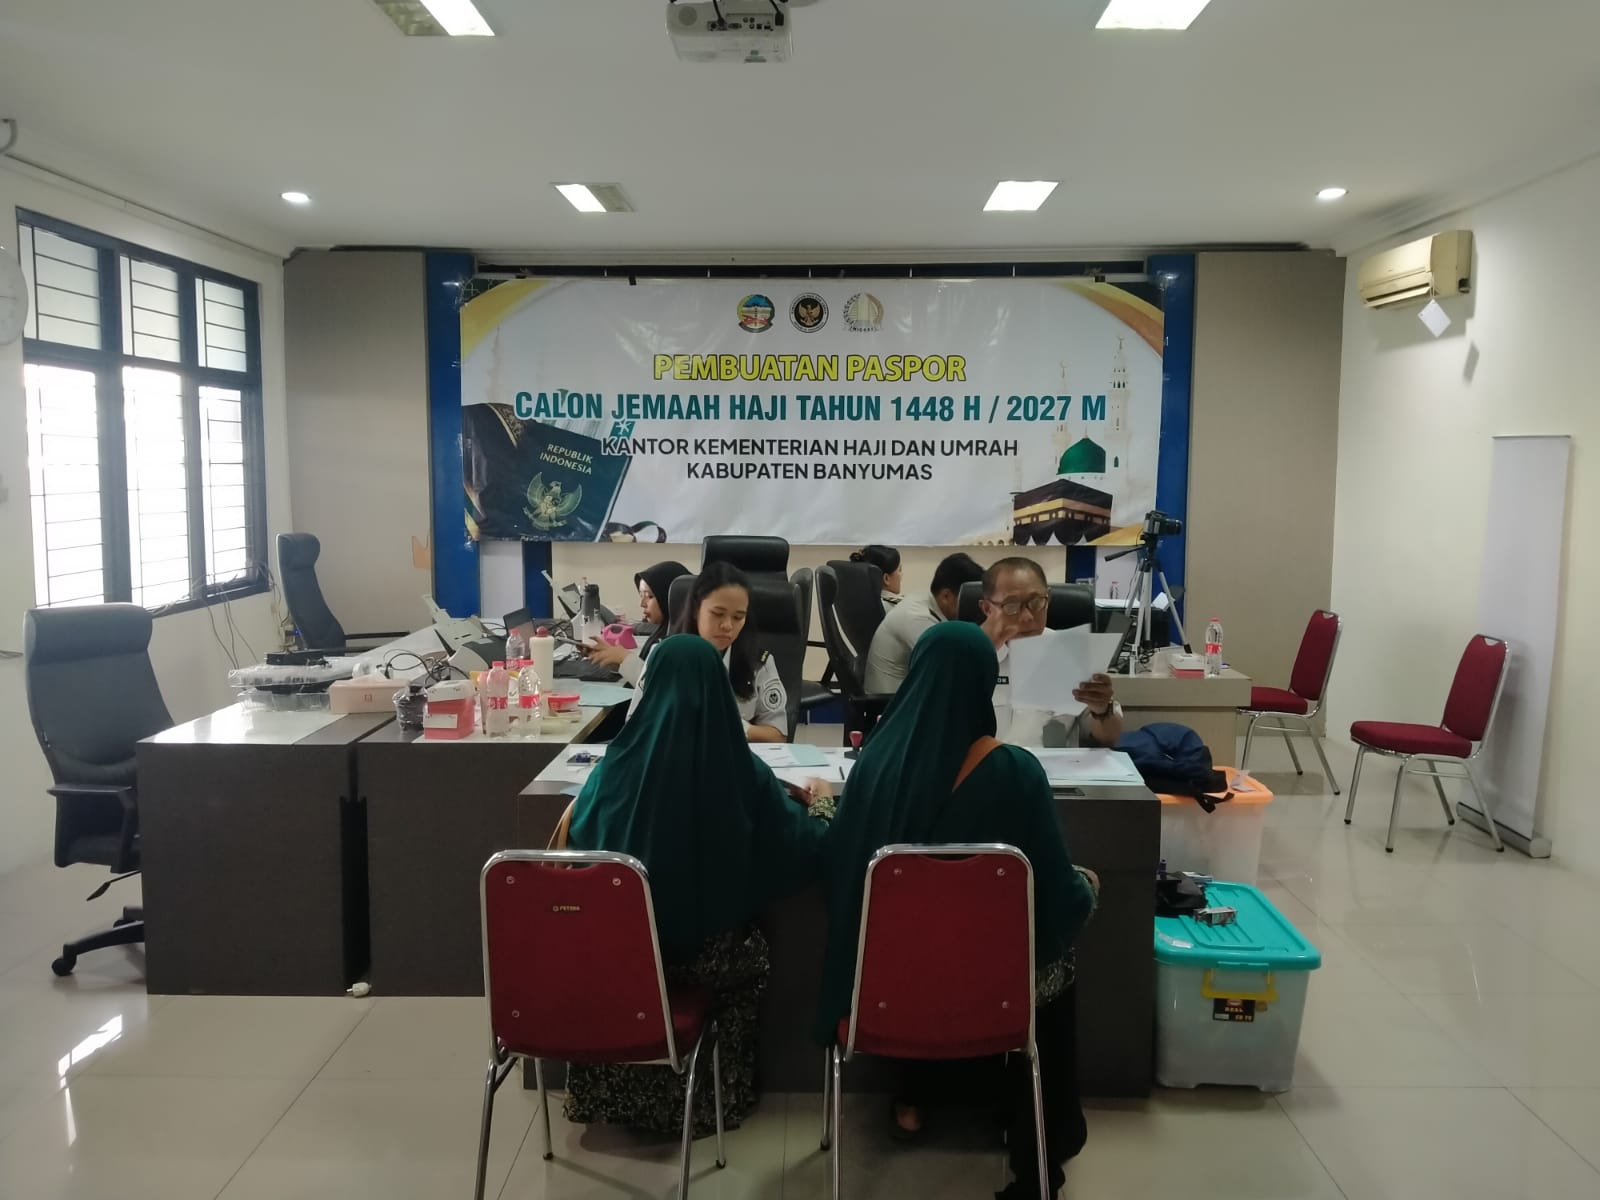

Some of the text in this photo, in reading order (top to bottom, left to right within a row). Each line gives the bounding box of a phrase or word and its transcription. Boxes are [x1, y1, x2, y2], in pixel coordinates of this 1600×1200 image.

[653, 353, 966, 382] PEMBUATAN PASPOR
[515, 391, 1106, 424] CALON JEMAAH HAJI TAHUN 1448 H / 2027 M
[547, 443, 592, 464] REPUBLIK
[602, 438, 1018, 456] KANTOR KEMENTERIAN HAJI DAN UMRAH
[540, 452, 592, 475] INDONESIA
[688, 462, 933, 480] KABUPATEN BANYUMAS
